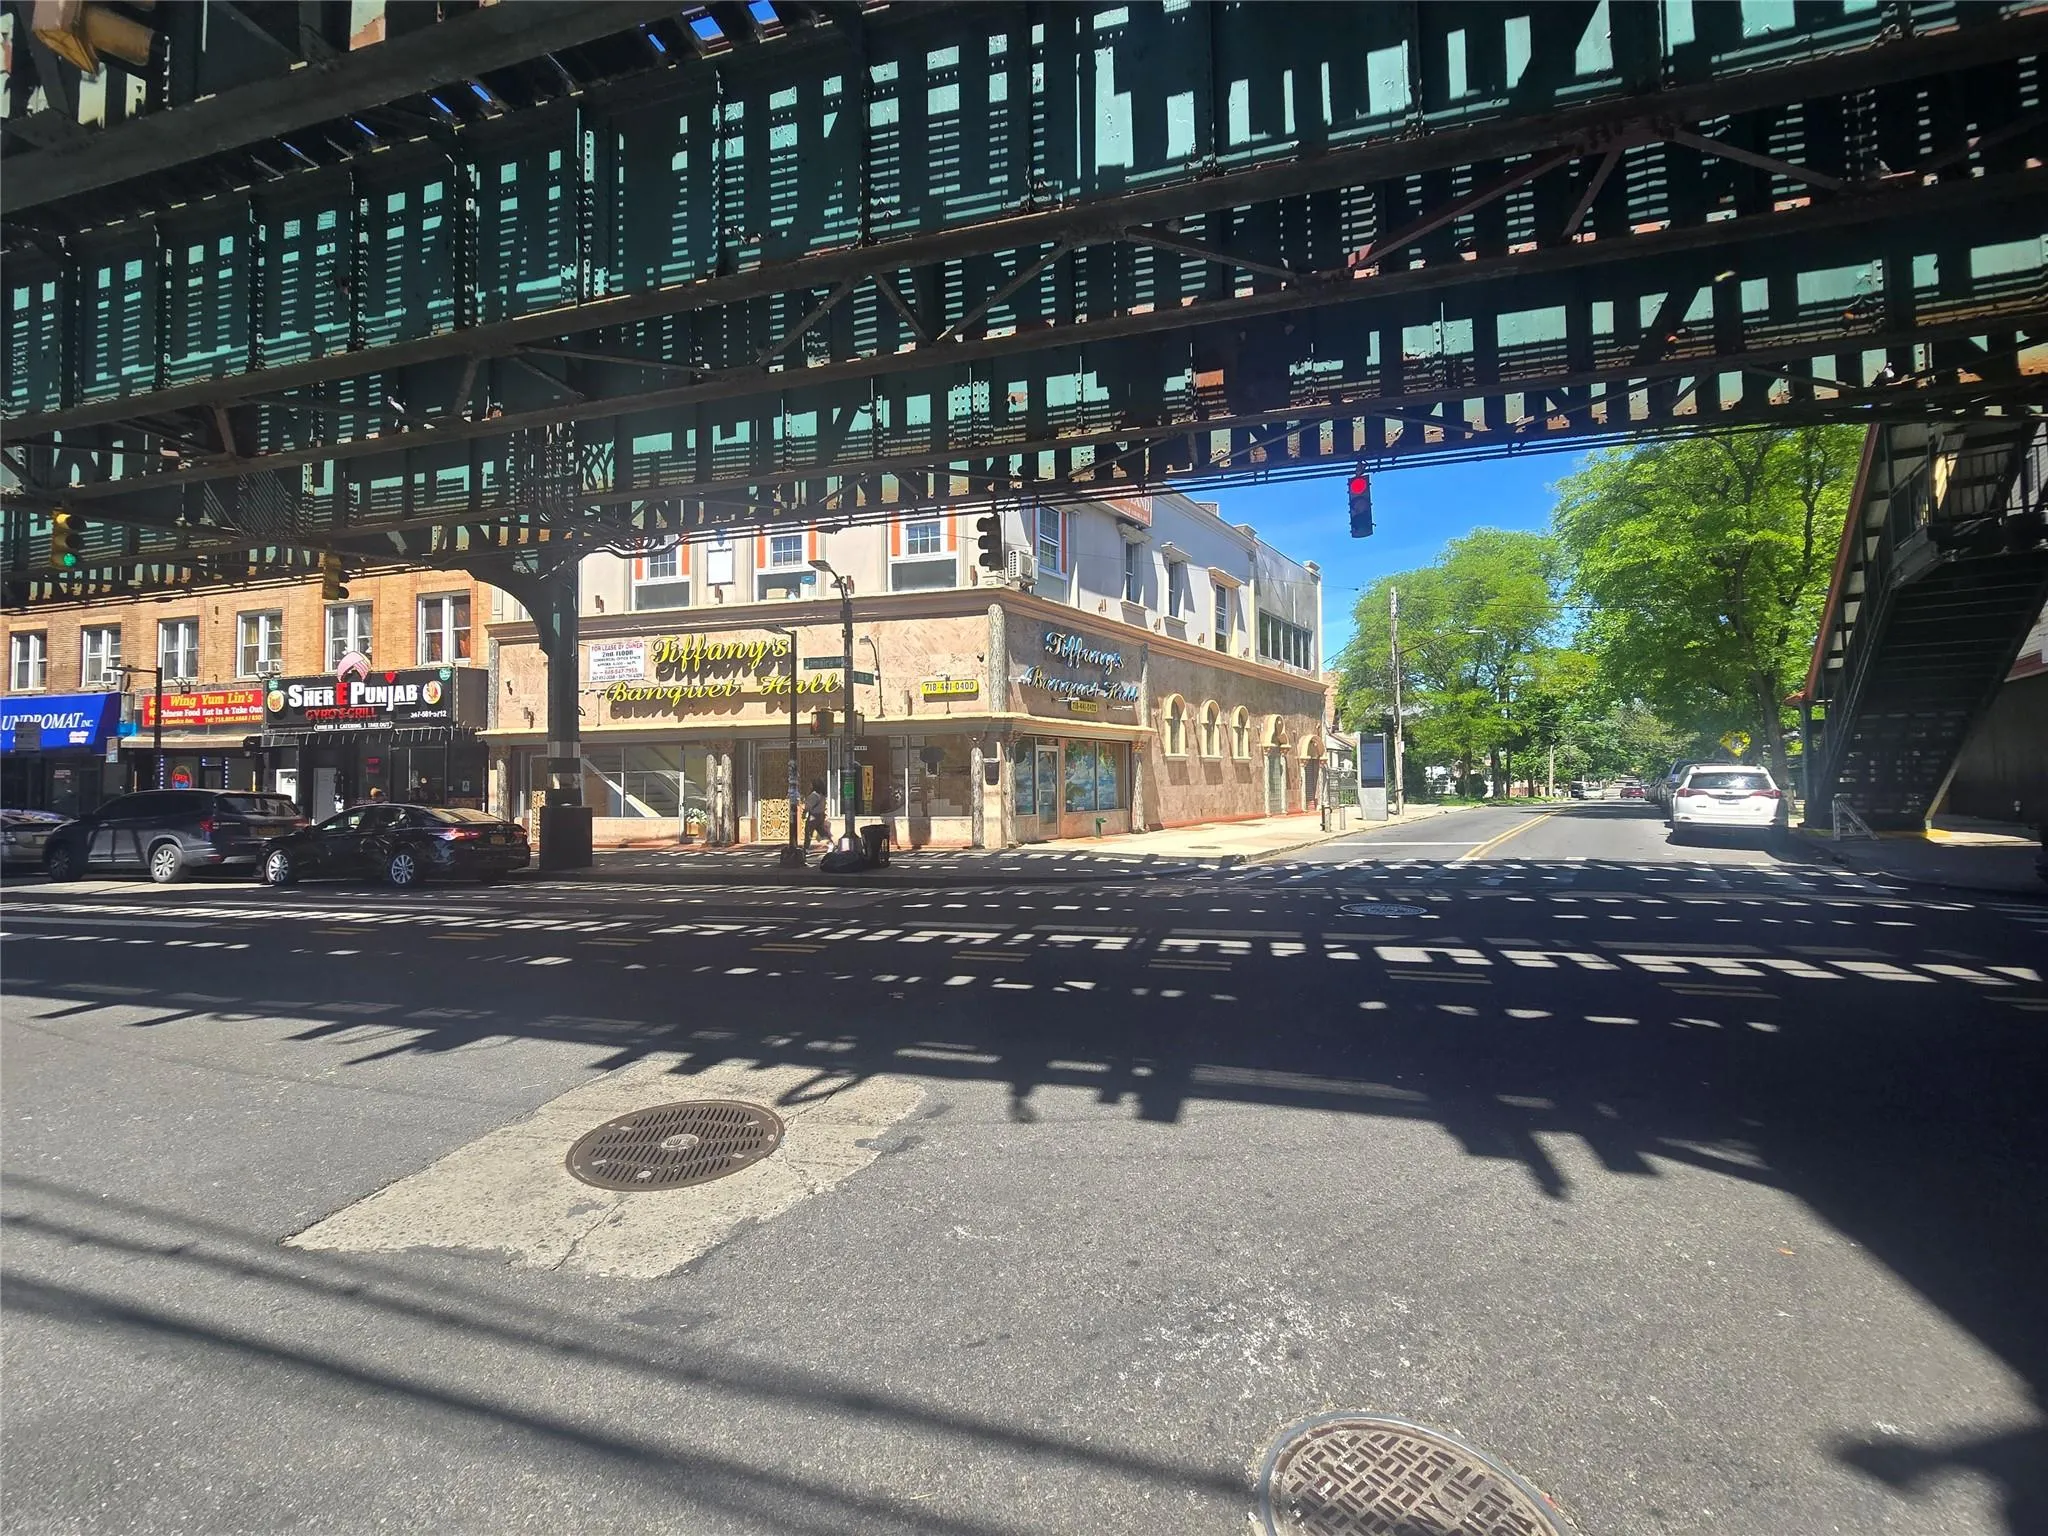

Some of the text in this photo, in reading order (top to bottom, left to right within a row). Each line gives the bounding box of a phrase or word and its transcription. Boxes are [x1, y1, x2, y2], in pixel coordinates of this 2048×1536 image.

[651, 634, 789, 671] Tiffany's
[170, 692, 253, 708] Wing Yum Lin's
[288, 684, 334, 708] SHER
[336, 683, 349, 705] E
[350, 681, 418, 711] PUNJAB
[605, 680, 741, 705] Banquet
[760, 672, 842, 696] Hall
[0, 713, 83, 730] UNDROMAT
[184, 708, 200, 716] Food
